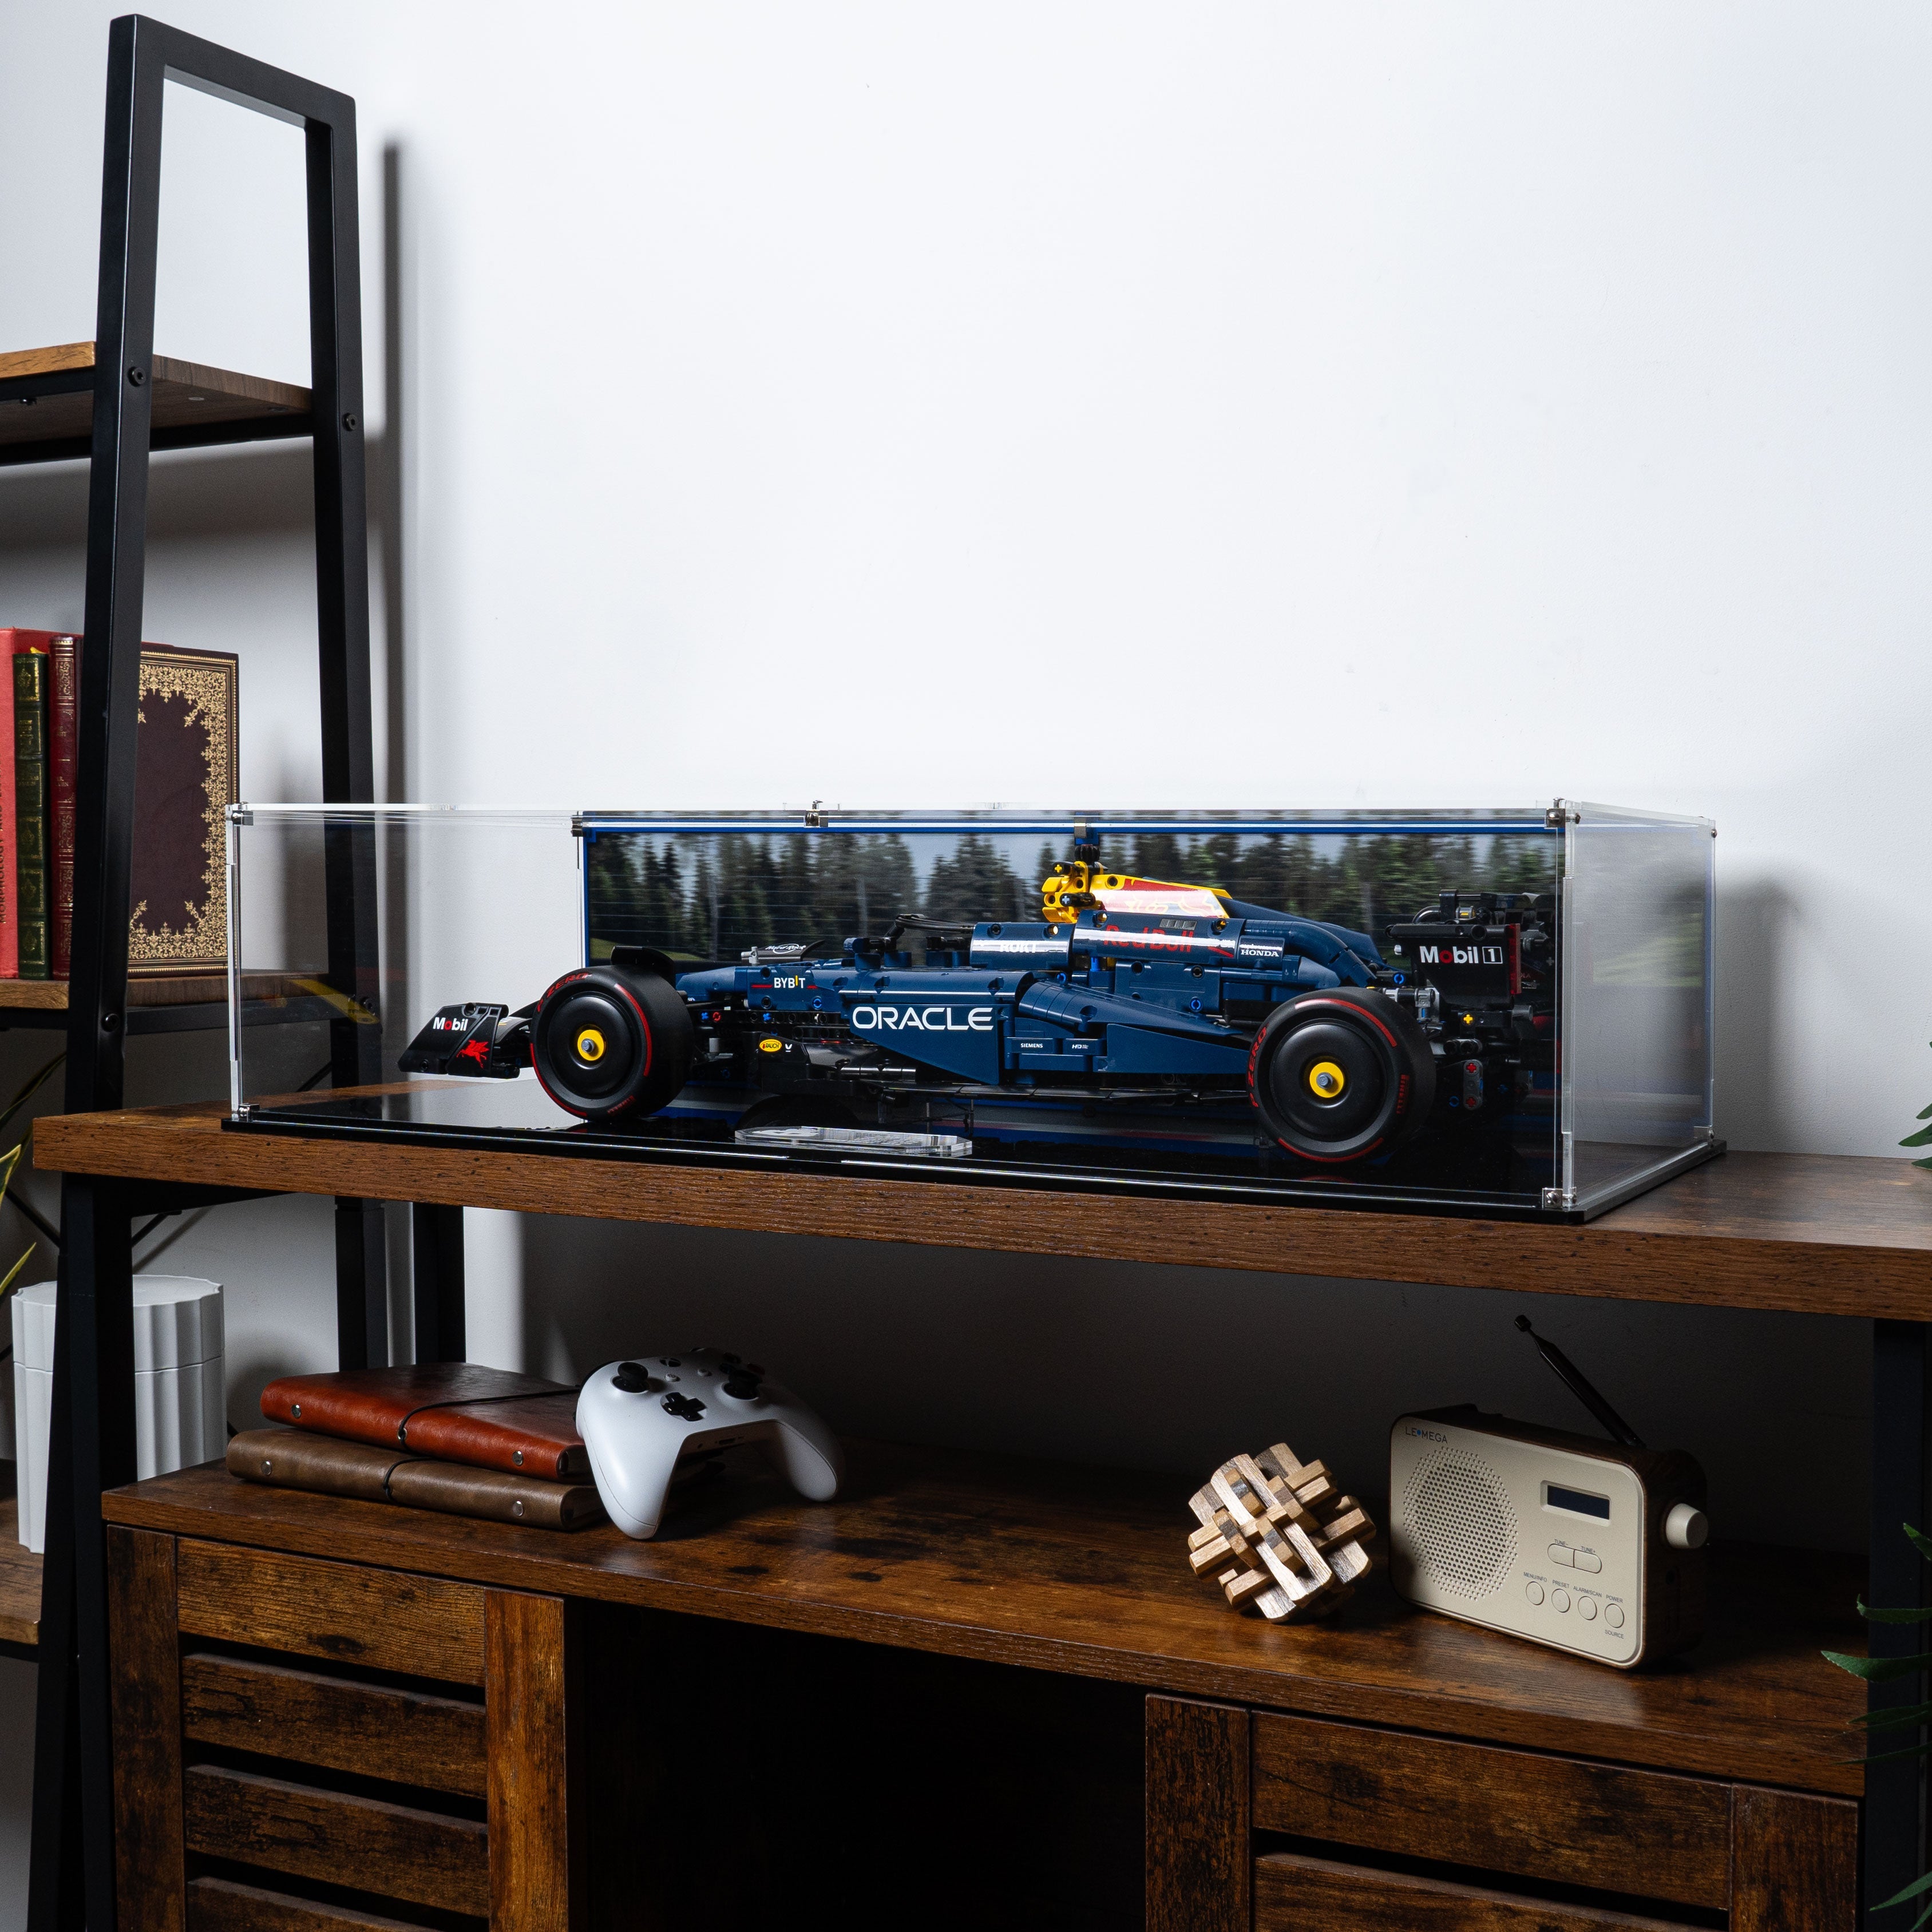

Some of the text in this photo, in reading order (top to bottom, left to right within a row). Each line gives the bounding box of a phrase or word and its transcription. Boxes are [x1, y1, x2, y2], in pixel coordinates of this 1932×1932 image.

[1419, 946, 1479, 964] Mobil
[774, 975, 806, 989] BYBIT
[433, 1017, 468, 1031] Mobil
[852, 1007, 994, 1030] ORACLE
[1553, 1579, 1569, 1589] PRESET
[1606, 1594, 1624, 1603] POWER
[1605, 1629, 1625, 1639] SOURCE
